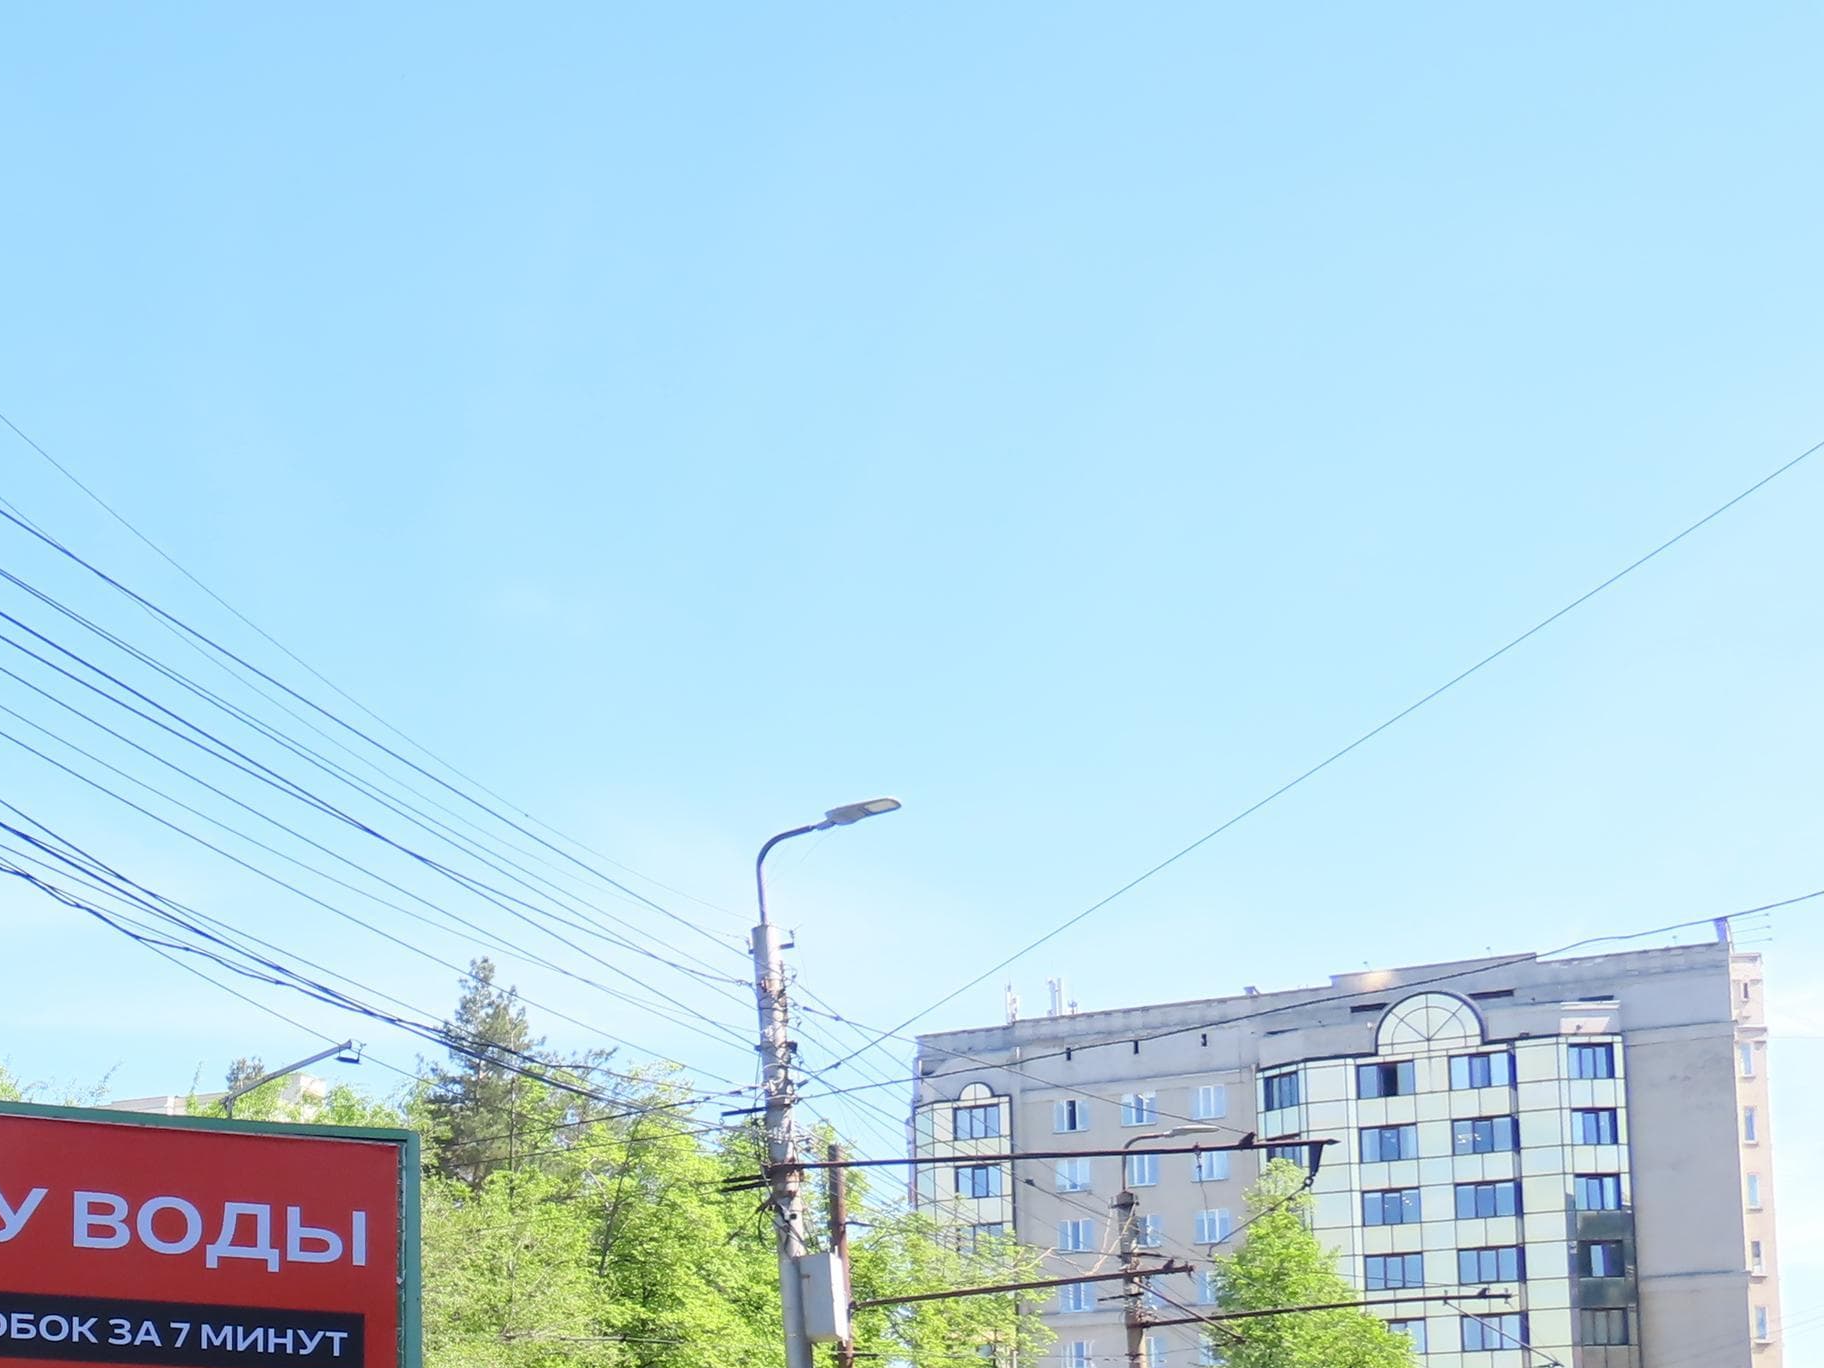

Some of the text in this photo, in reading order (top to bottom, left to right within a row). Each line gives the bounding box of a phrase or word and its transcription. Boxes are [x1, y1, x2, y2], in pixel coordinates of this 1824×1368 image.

[72, 1190, 367, 1273] ВОДЫ
[107, 1317, 163, 1348] ЗА
[169, 1321, 191, 1349] 7
[200, 1323, 349, 1358] МИНУТ
